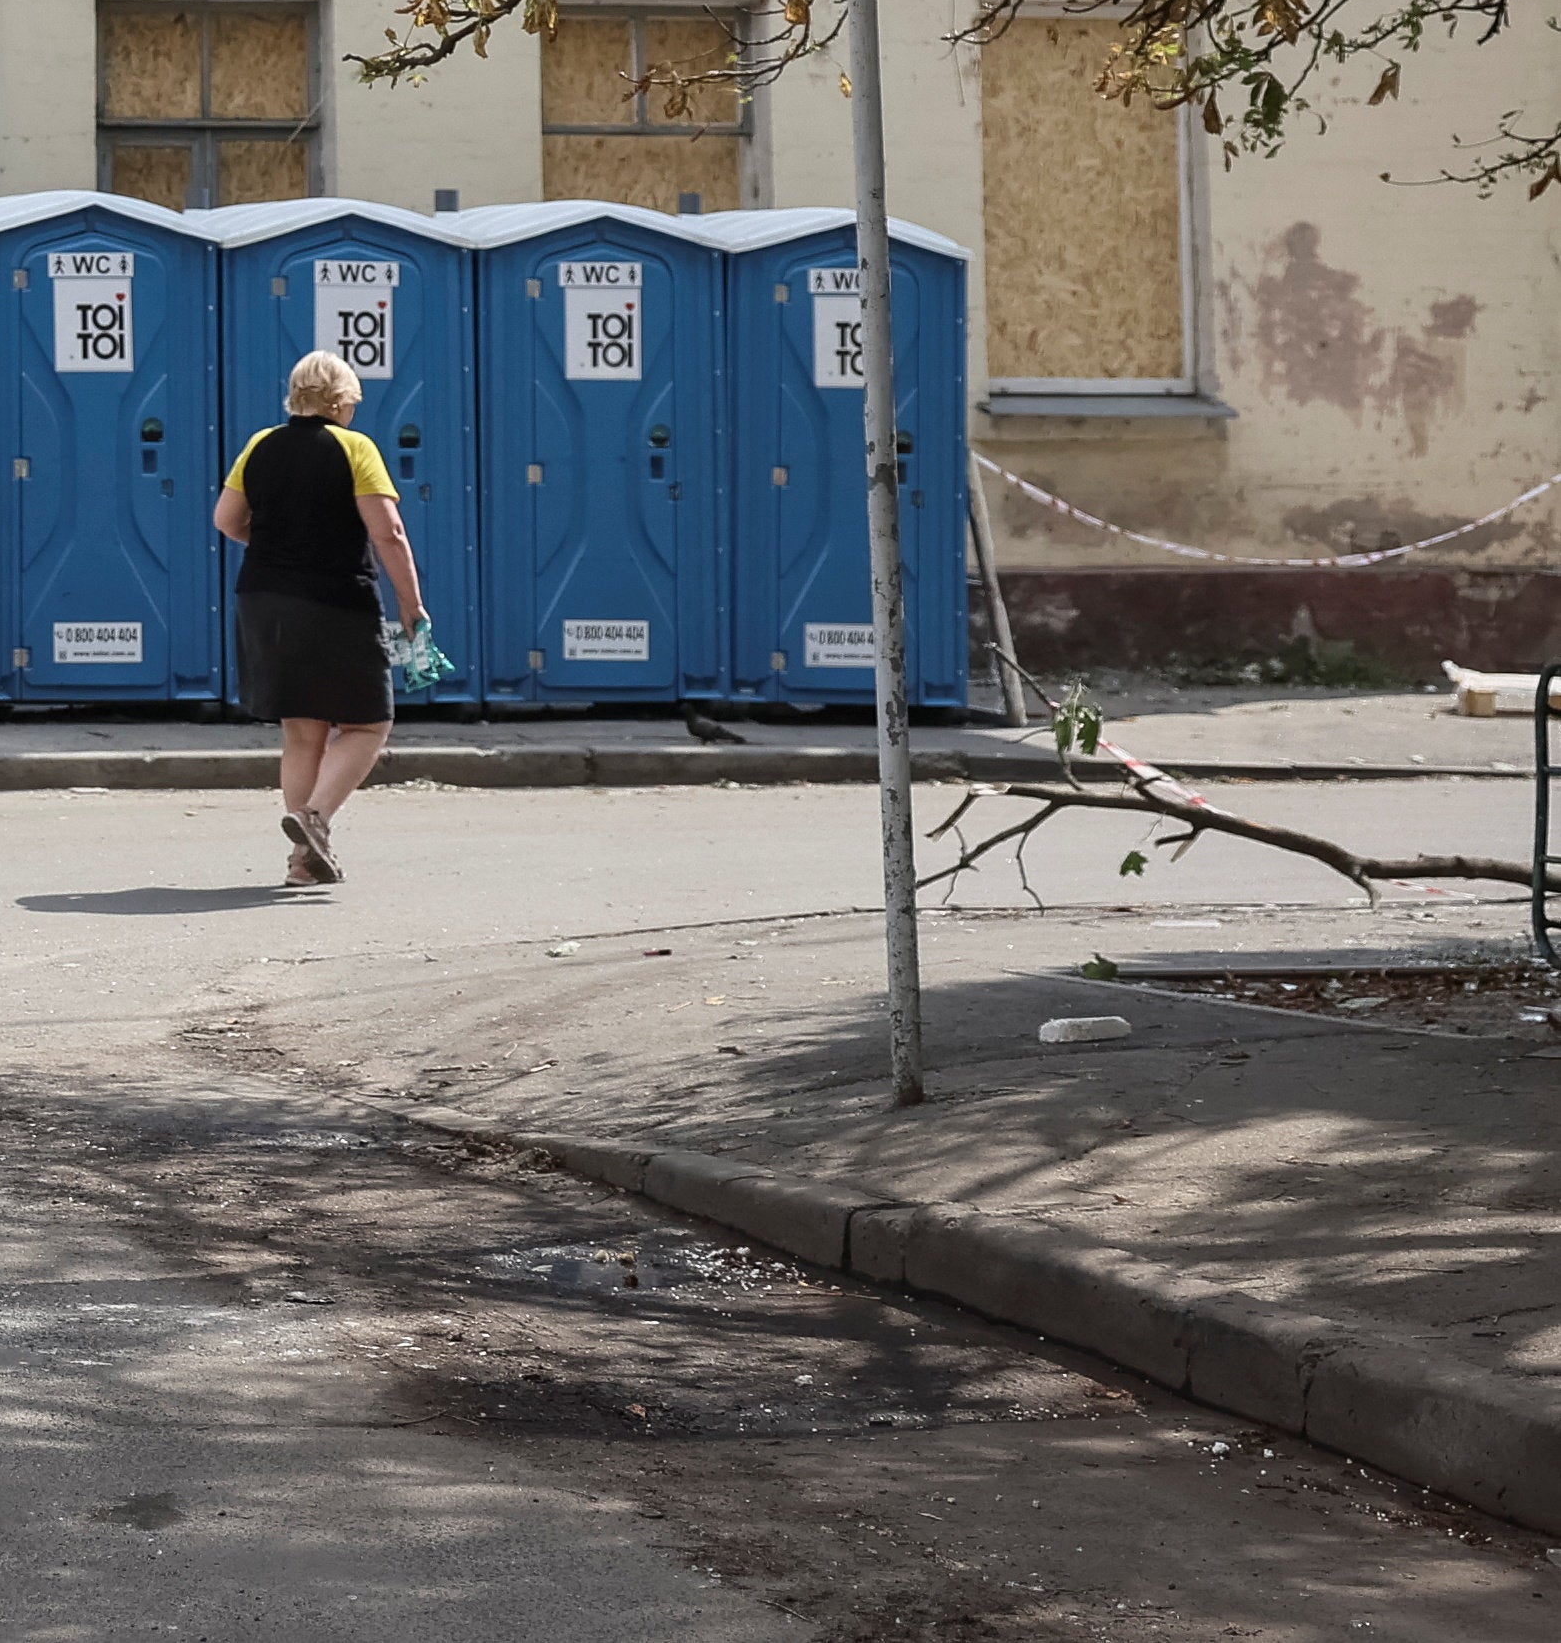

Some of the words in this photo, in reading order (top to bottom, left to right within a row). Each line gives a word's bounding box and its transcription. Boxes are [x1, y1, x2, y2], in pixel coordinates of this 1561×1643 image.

[73, 255, 111, 274] WC
[338, 264, 376, 283] WC
[582, 265, 620, 284] WC
[833, 272, 860, 290] W
[77, 332, 125, 360] TOI
[338, 340, 385, 367] TOI
[586, 341, 634, 368] TOI
[66, 628, 73, 643] 0
[74, 628, 95, 643] 800
[97, 628, 116, 642] 404
[118, 628, 138, 642] 404
[584, 624, 603, 641] 800
[604, 625, 624, 641] 404
[625, 626, 645, 641] 404
